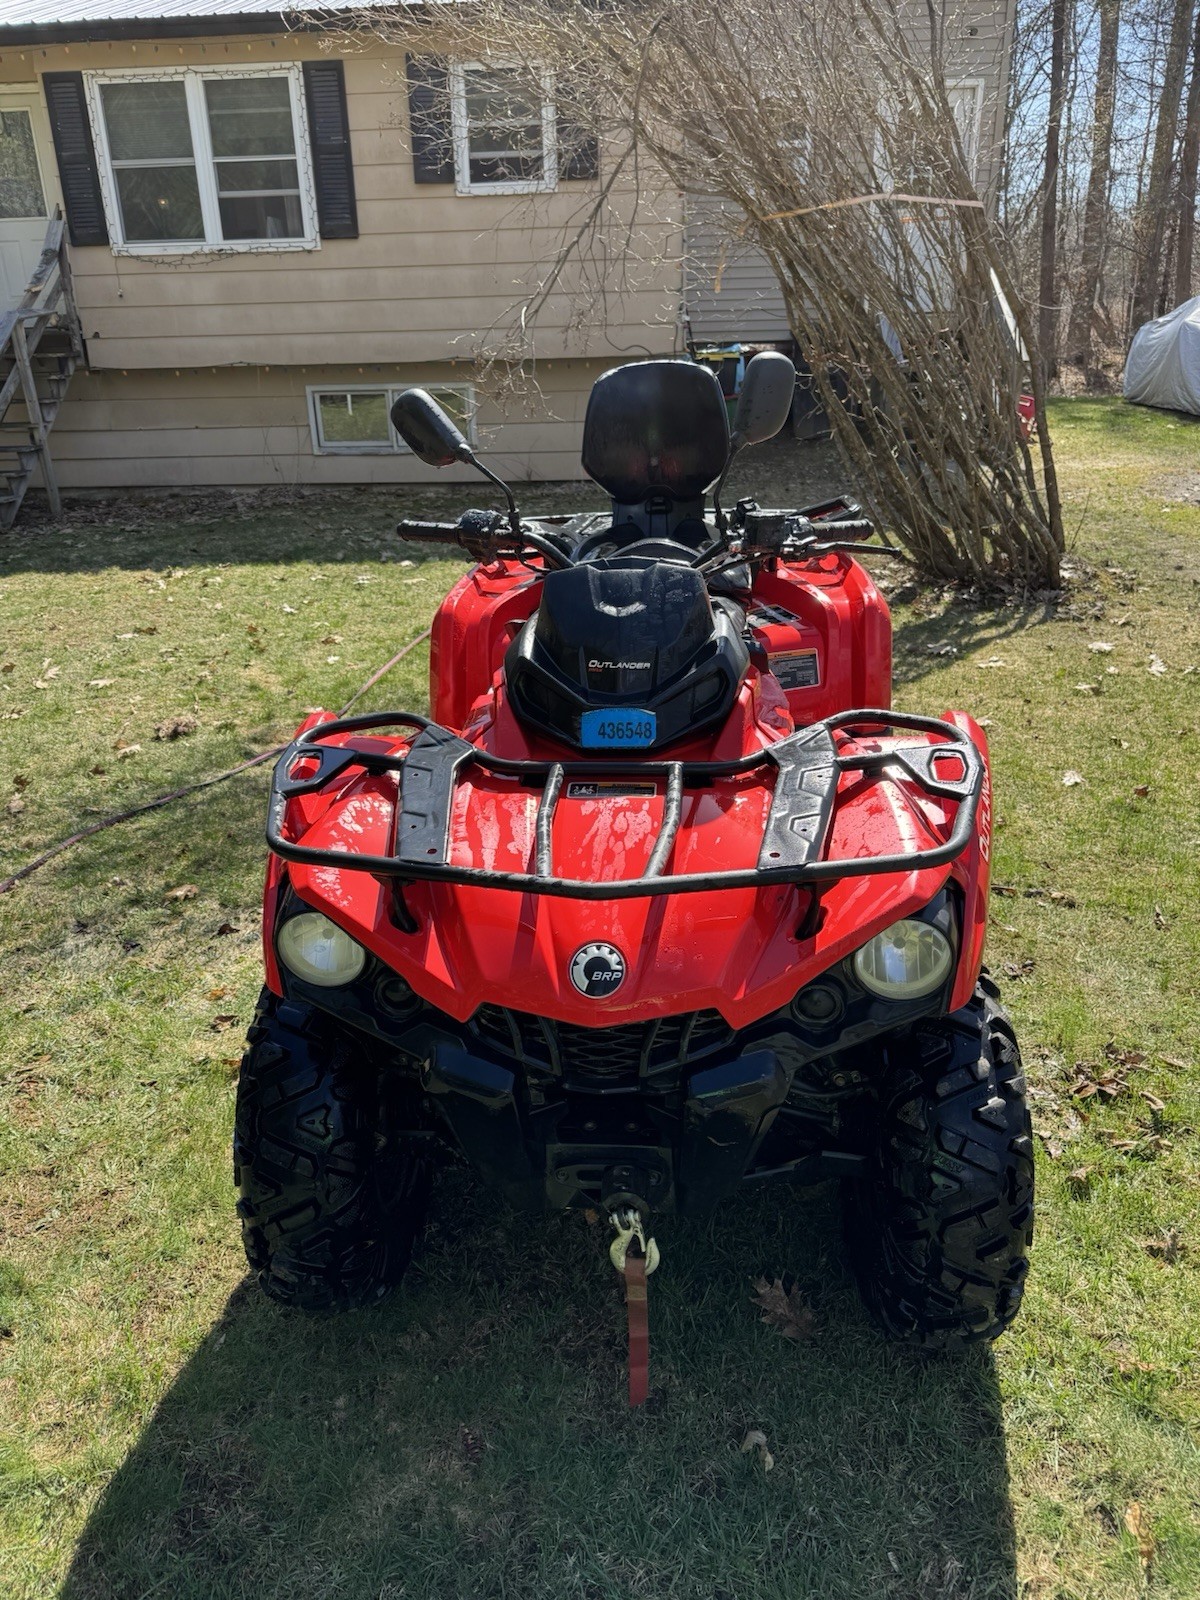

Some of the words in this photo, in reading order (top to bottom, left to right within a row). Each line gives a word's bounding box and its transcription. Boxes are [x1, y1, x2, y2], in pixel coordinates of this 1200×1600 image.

[588, 660, 651, 669] OUTLANDER
[598, 721, 653, 740] 436548
[591, 971, 622, 981] BRP
